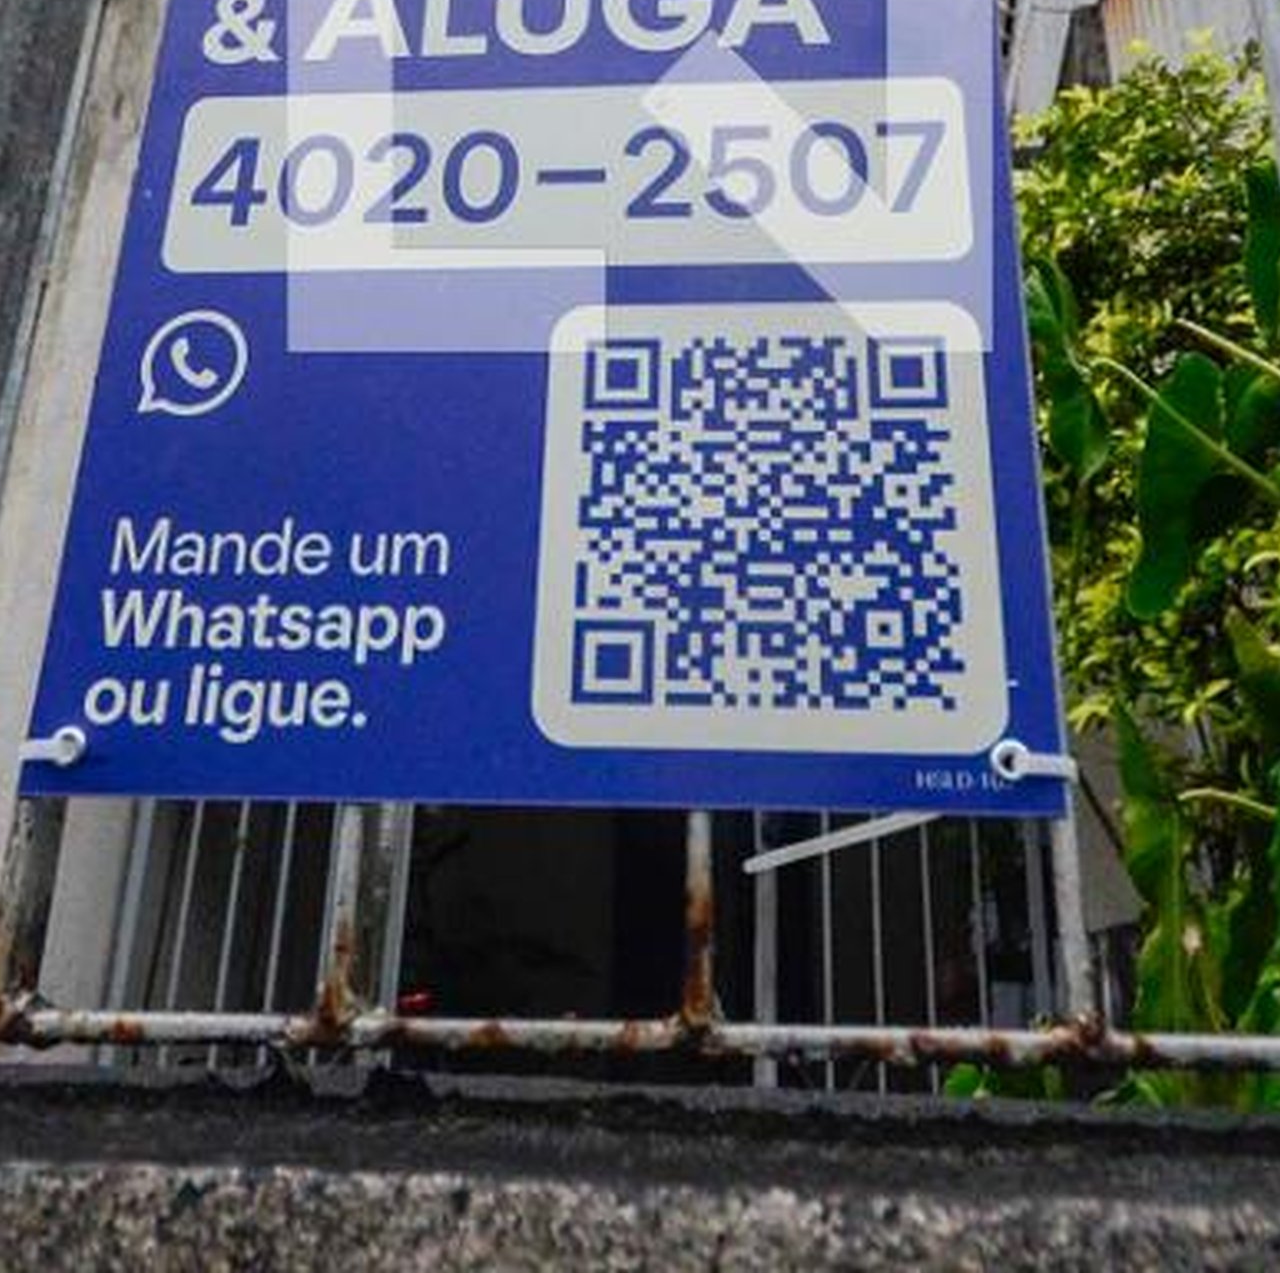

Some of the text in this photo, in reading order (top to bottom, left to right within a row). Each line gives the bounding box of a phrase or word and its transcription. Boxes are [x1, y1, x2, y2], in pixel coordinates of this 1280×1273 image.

[110, 518, 449, 576] Mande um
[101, 589, 446, 665] Whatsapp
[83, 663, 367, 743] ou ligue.
